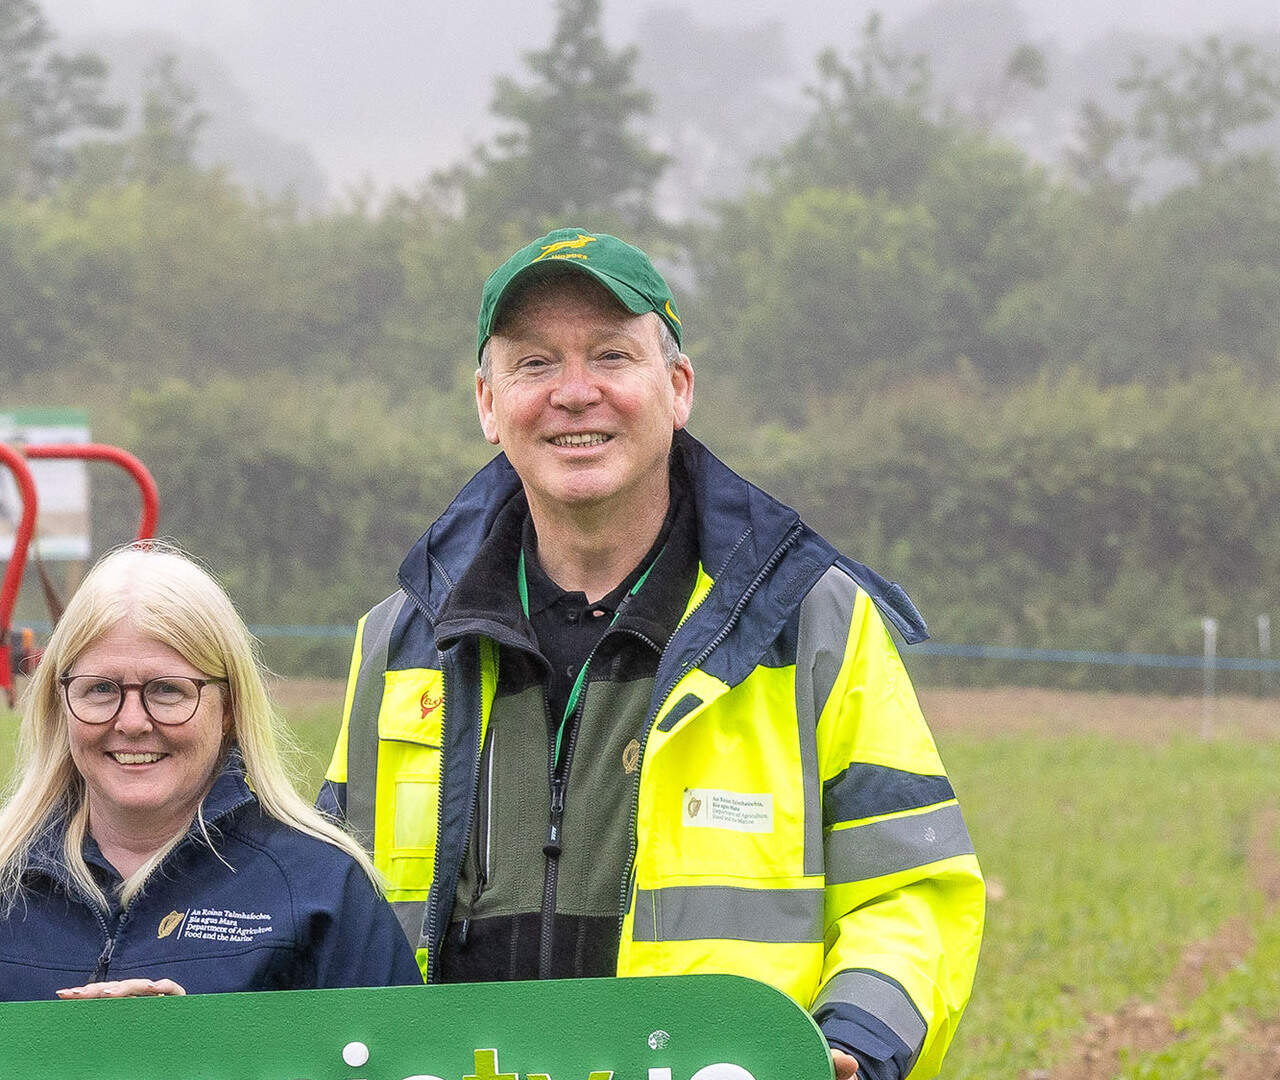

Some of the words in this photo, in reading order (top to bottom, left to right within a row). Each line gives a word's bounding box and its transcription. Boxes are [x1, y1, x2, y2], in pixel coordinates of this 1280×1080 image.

[185, 924, 228, 933] Department
[184, 931, 203, 939] Food
[203, 932, 216, 940] and
